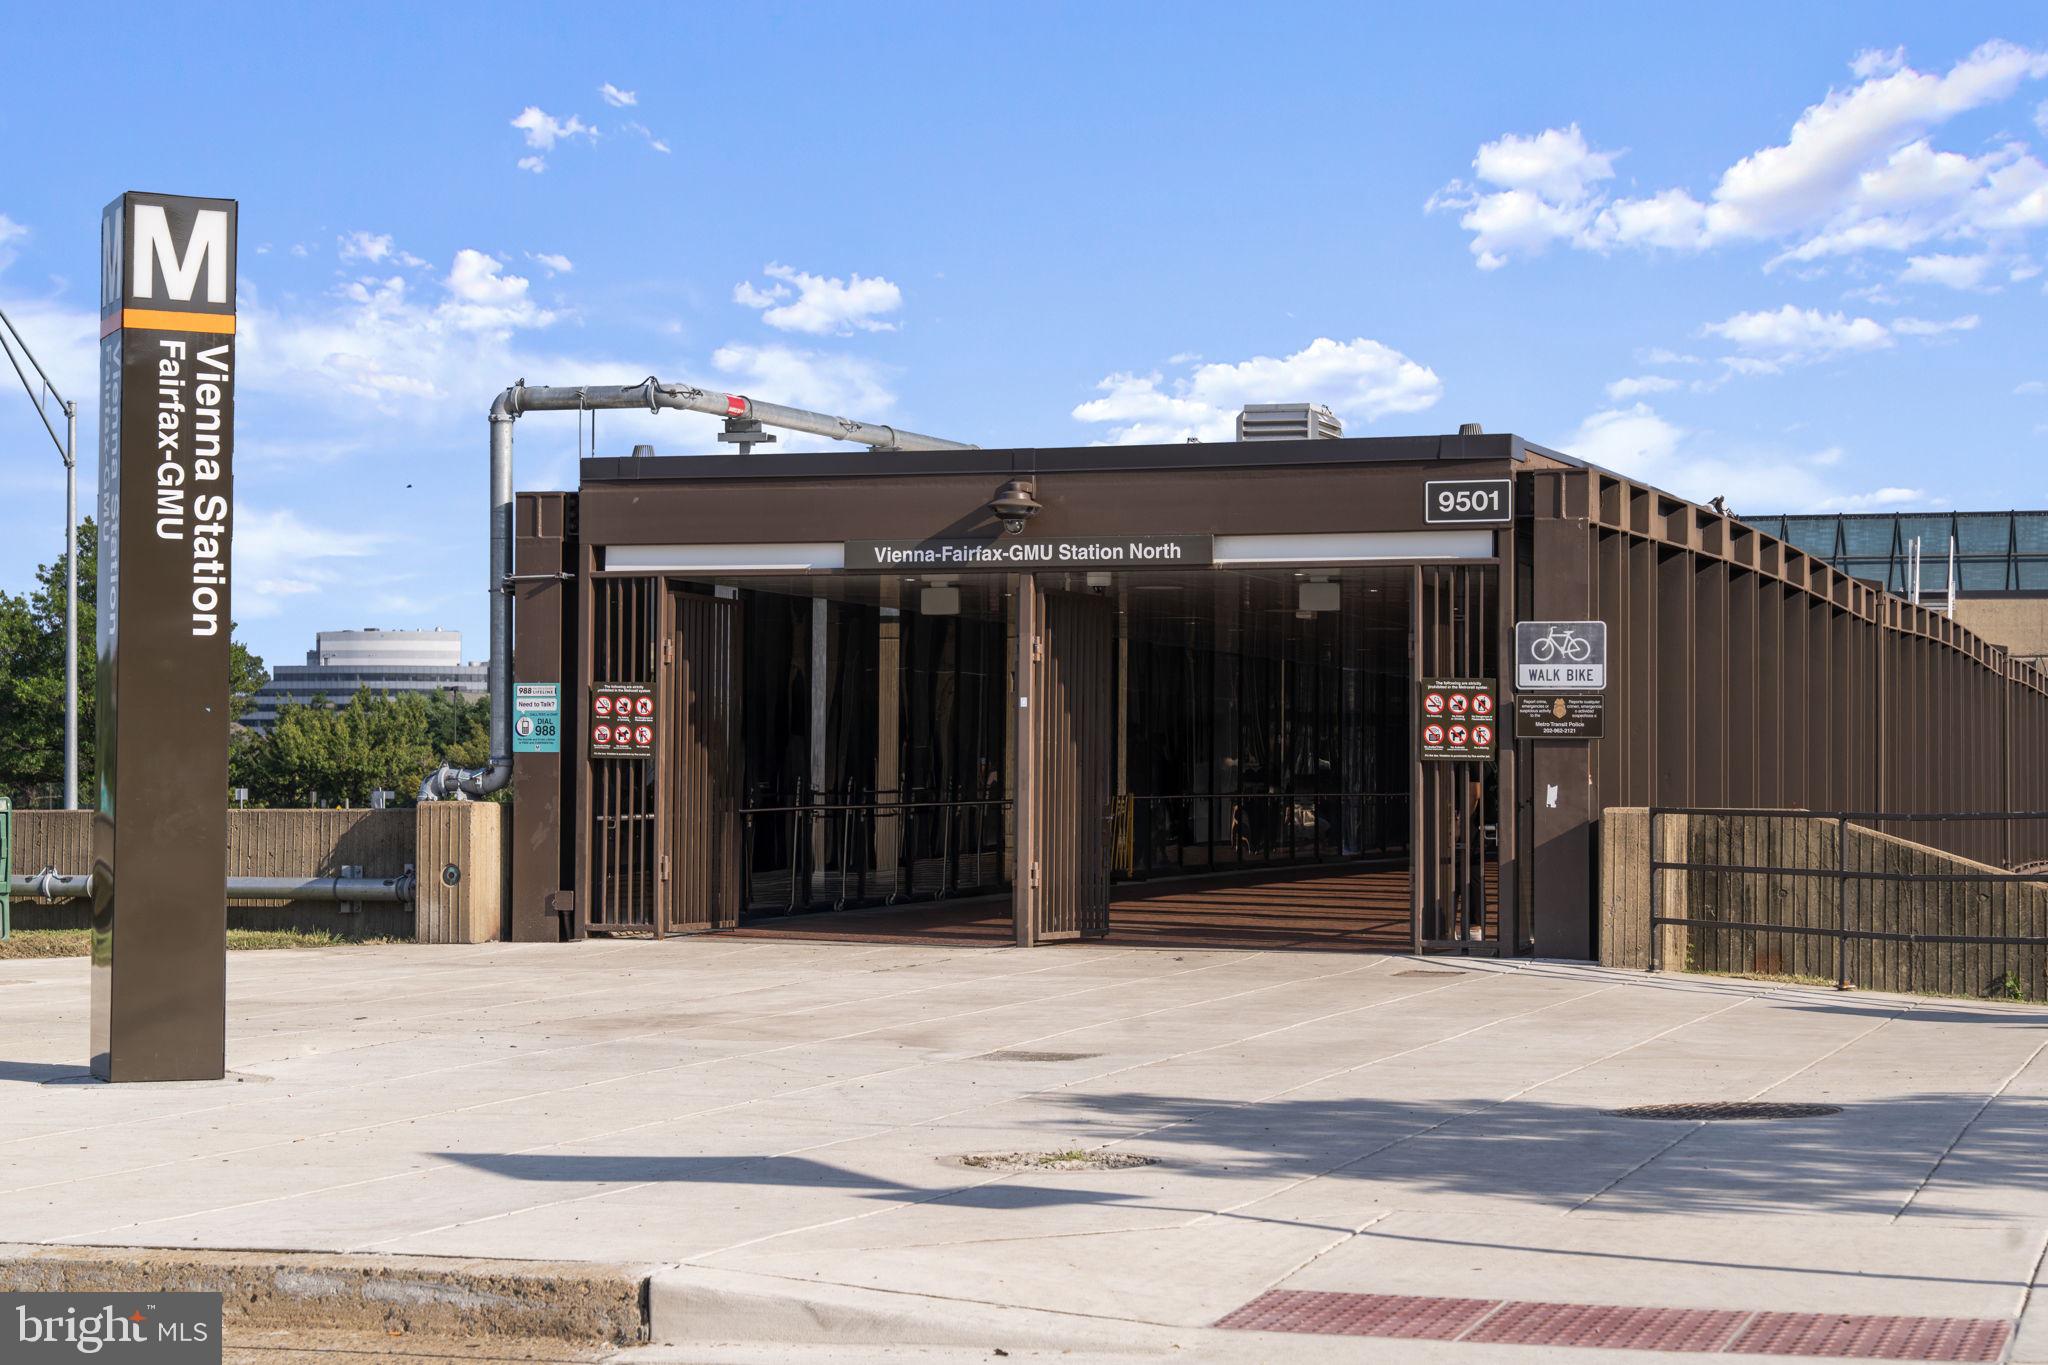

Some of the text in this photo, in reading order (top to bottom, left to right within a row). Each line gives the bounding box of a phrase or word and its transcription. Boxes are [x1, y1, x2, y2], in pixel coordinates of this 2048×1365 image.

[132, 204, 228, 304] M
[156, 340, 187, 540] Fairfax-GMU
[192, 344, 229, 636] Vienna Station
[1438, 490, 1499, 512] 9501
[874, 542, 1182, 563] Vienna-Fairfax-GMU Station North
[1528, 669, 1594, 681] WALK BIKE
[535, 725, 556, 736] 988
